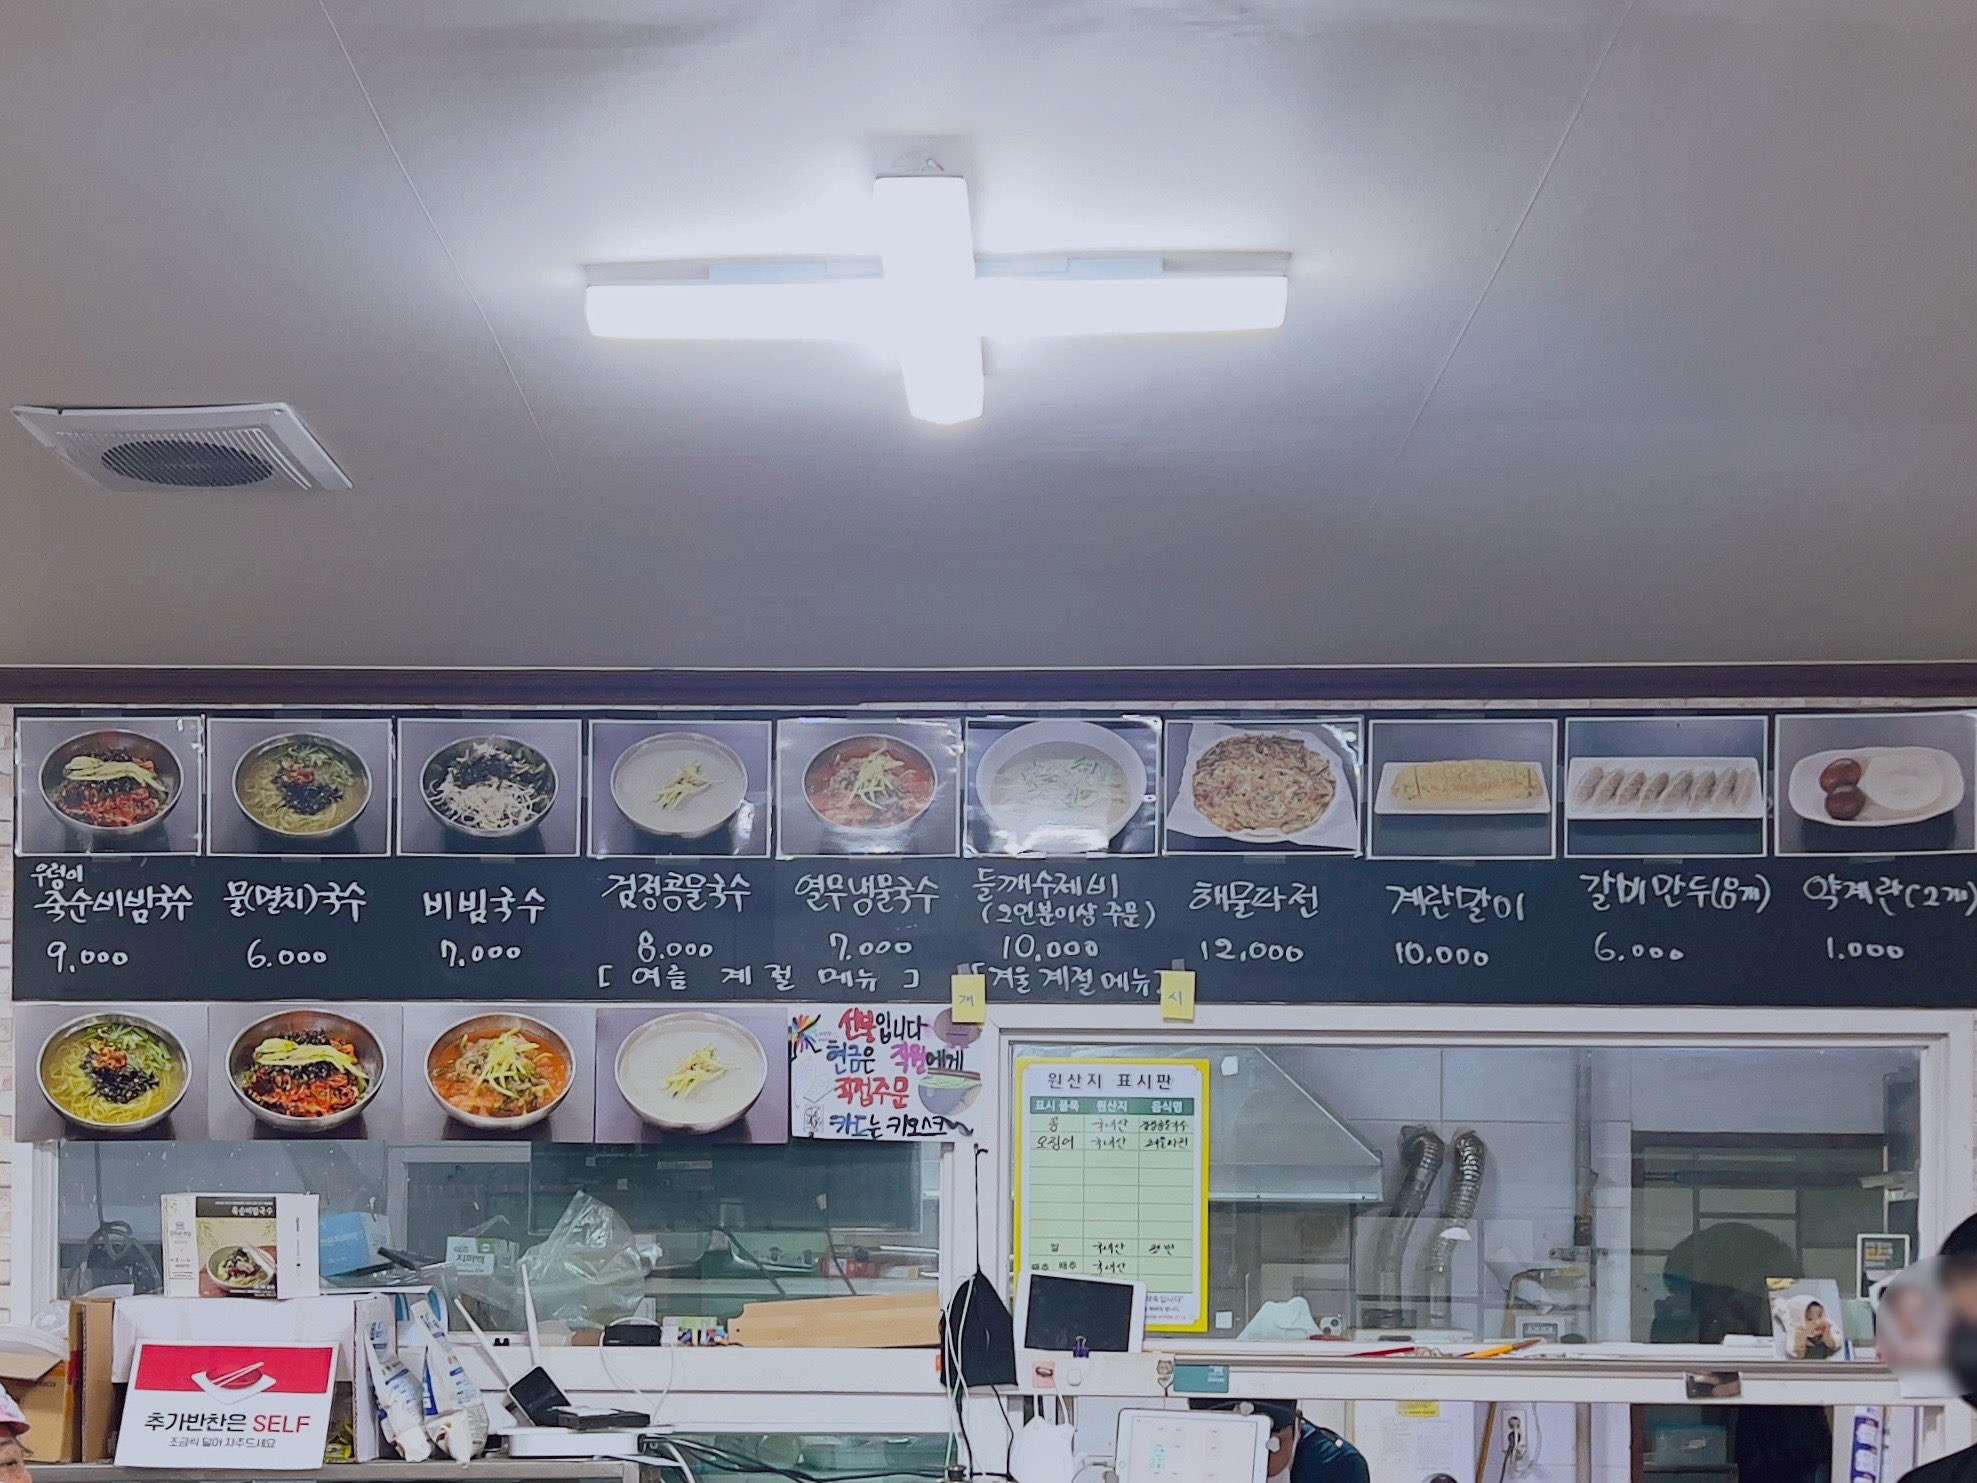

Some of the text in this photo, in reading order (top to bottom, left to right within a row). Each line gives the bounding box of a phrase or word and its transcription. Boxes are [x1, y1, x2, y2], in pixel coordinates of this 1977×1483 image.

[31, 862, 84, 888] 우렁이
[971, 867, 1119, 902] 들깨수제비
[33, 884, 194, 924] 죽순비빔국수
[223, 880, 367, 923] 물(멸치)국수
[422, 886, 546, 925] 비빔국수
[601, 872, 752, 912] 검정콩물국수
[794, 873, 940, 916] 열무냉물국수
[1188, 880, 1319, 919] 해물파전
[1385, 884, 1525, 924] 계란말이
[631, 964, 688, 991] 여름
[817, 968, 878, 992] 메뉴
[1037, 965, 1096, 997] 계절
[1167, 990, 1183, 1006] 시
[826, 1039, 964, 1075] 현금은 직원에게
[835, 1075, 910, 1109] 직접주문
[1048, 1072, 1173, 1091] 원산지 표시판
[1034, 1100, 1056, 1112] 표시
[1095, 1100, 1128, 1113] 원산지
[1150, 1100, 1183, 1114] 음식명
[1037, 1134, 1074, 1151] 오징어
[144, 1413, 311, 1433] 추가반찬은 SELF
[168, 1437, 200, 1448] 조금씩
